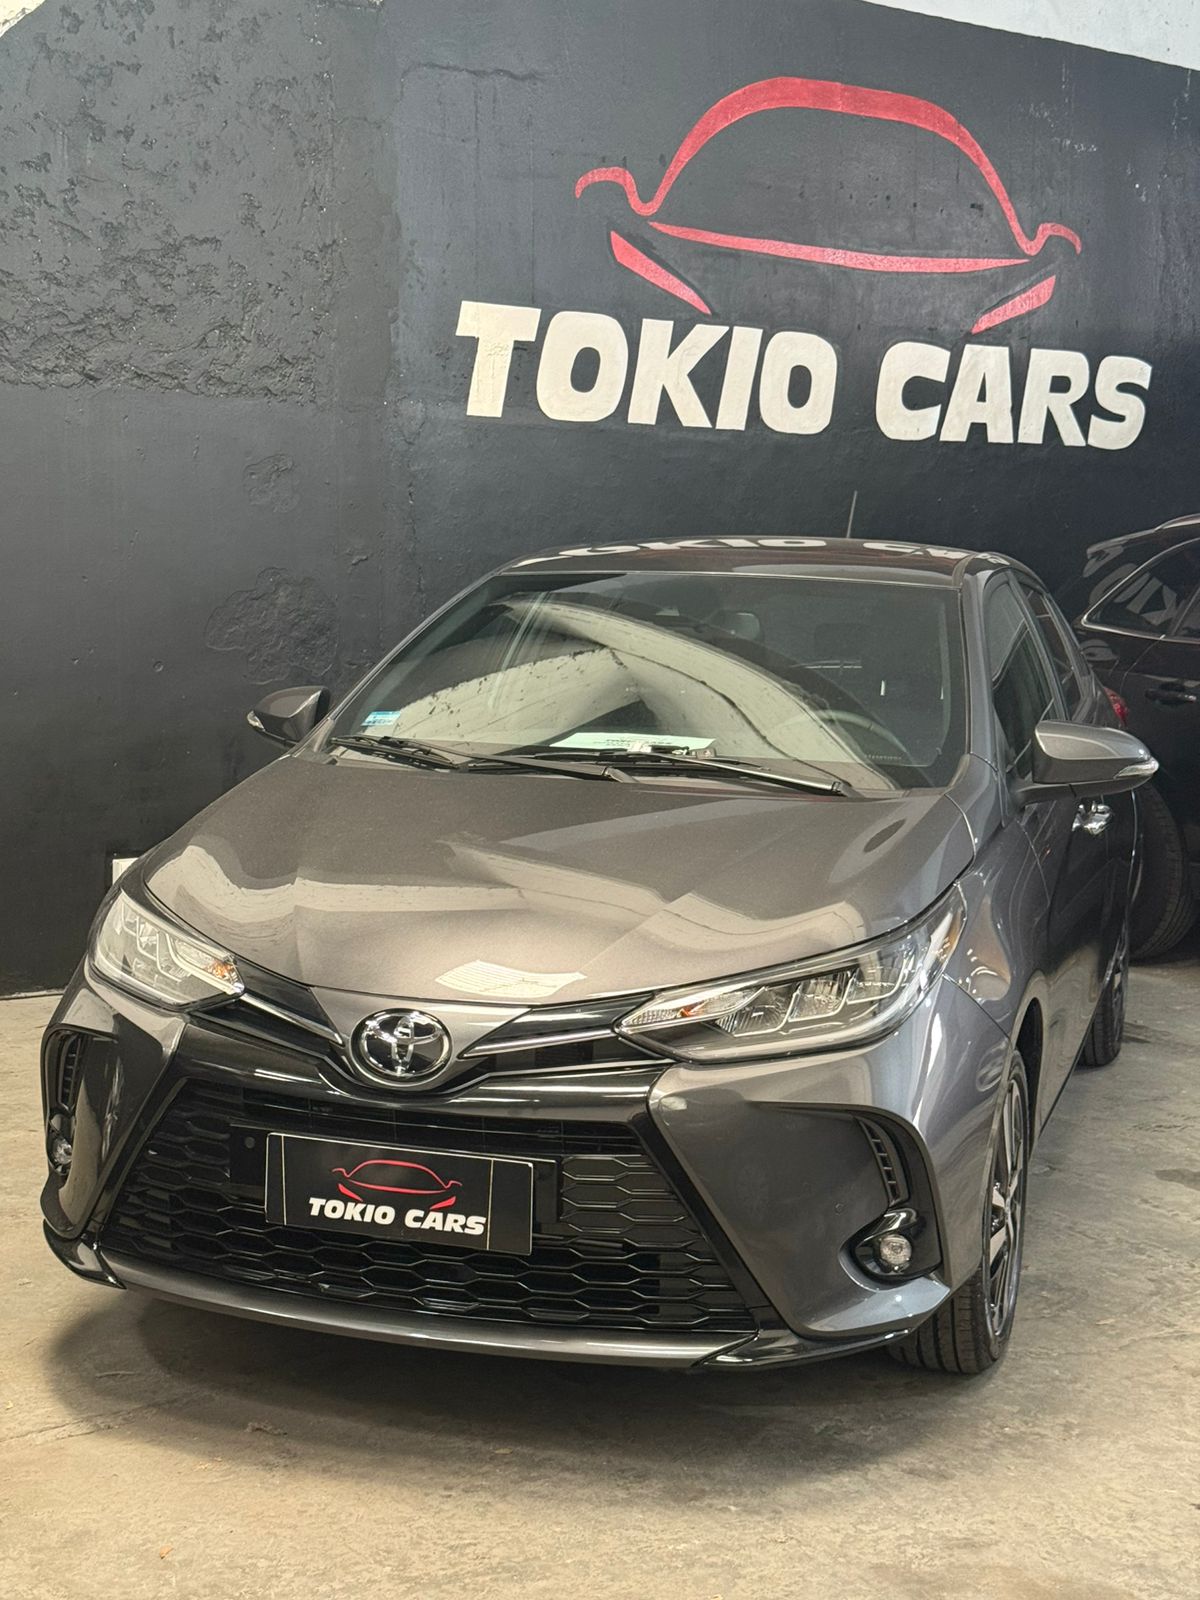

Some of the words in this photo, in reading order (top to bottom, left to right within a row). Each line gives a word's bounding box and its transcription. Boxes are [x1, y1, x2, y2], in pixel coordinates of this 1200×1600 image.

[455, 300, 838, 435] TOKIO
[875, 341, 1153, 450] CARS
[308, 1197, 396, 1225] TOKIO
[404, 1209, 487, 1235] CARS
